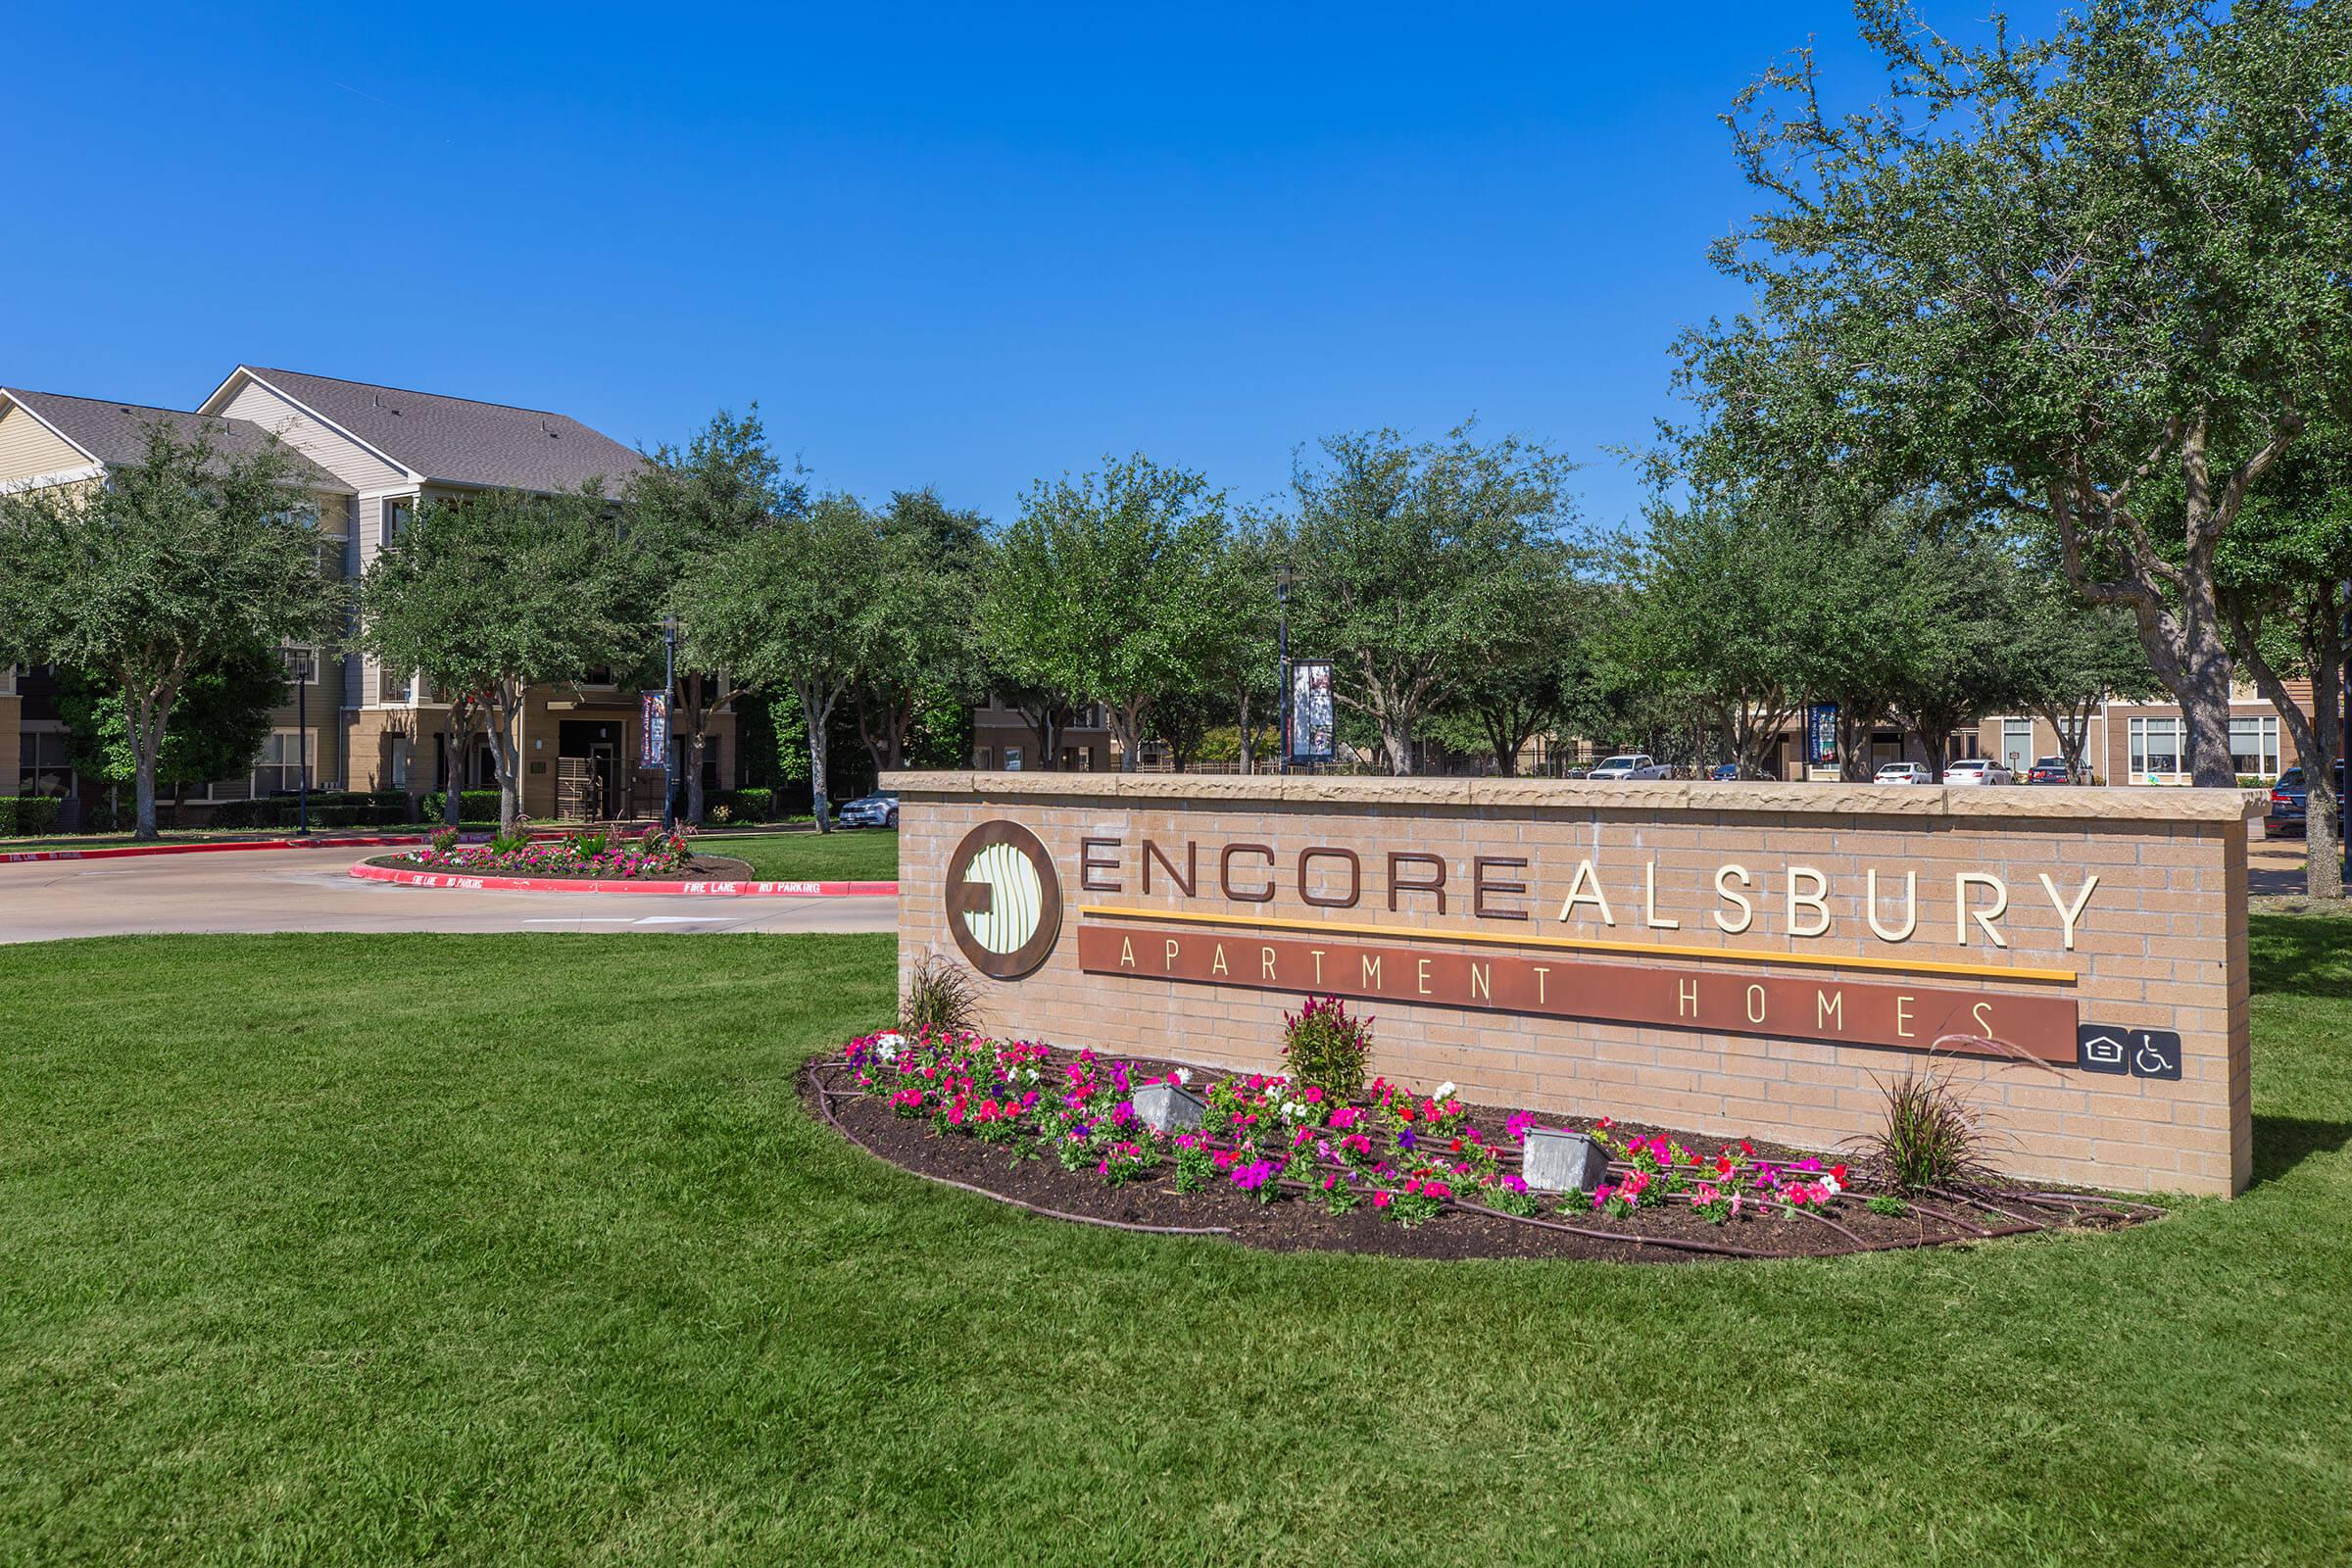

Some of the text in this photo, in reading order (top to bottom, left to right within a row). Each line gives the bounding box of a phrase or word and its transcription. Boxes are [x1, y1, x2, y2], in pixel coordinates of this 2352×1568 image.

[456, 878, 483, 889] PARKING
[684, 882, 820, 894] FIRE LANE NO PARKING
[1081, 837, 2099, 951] ENCORE ALSBURY
[1120, 936, 1992, 1041] APARTMENT HOMES
